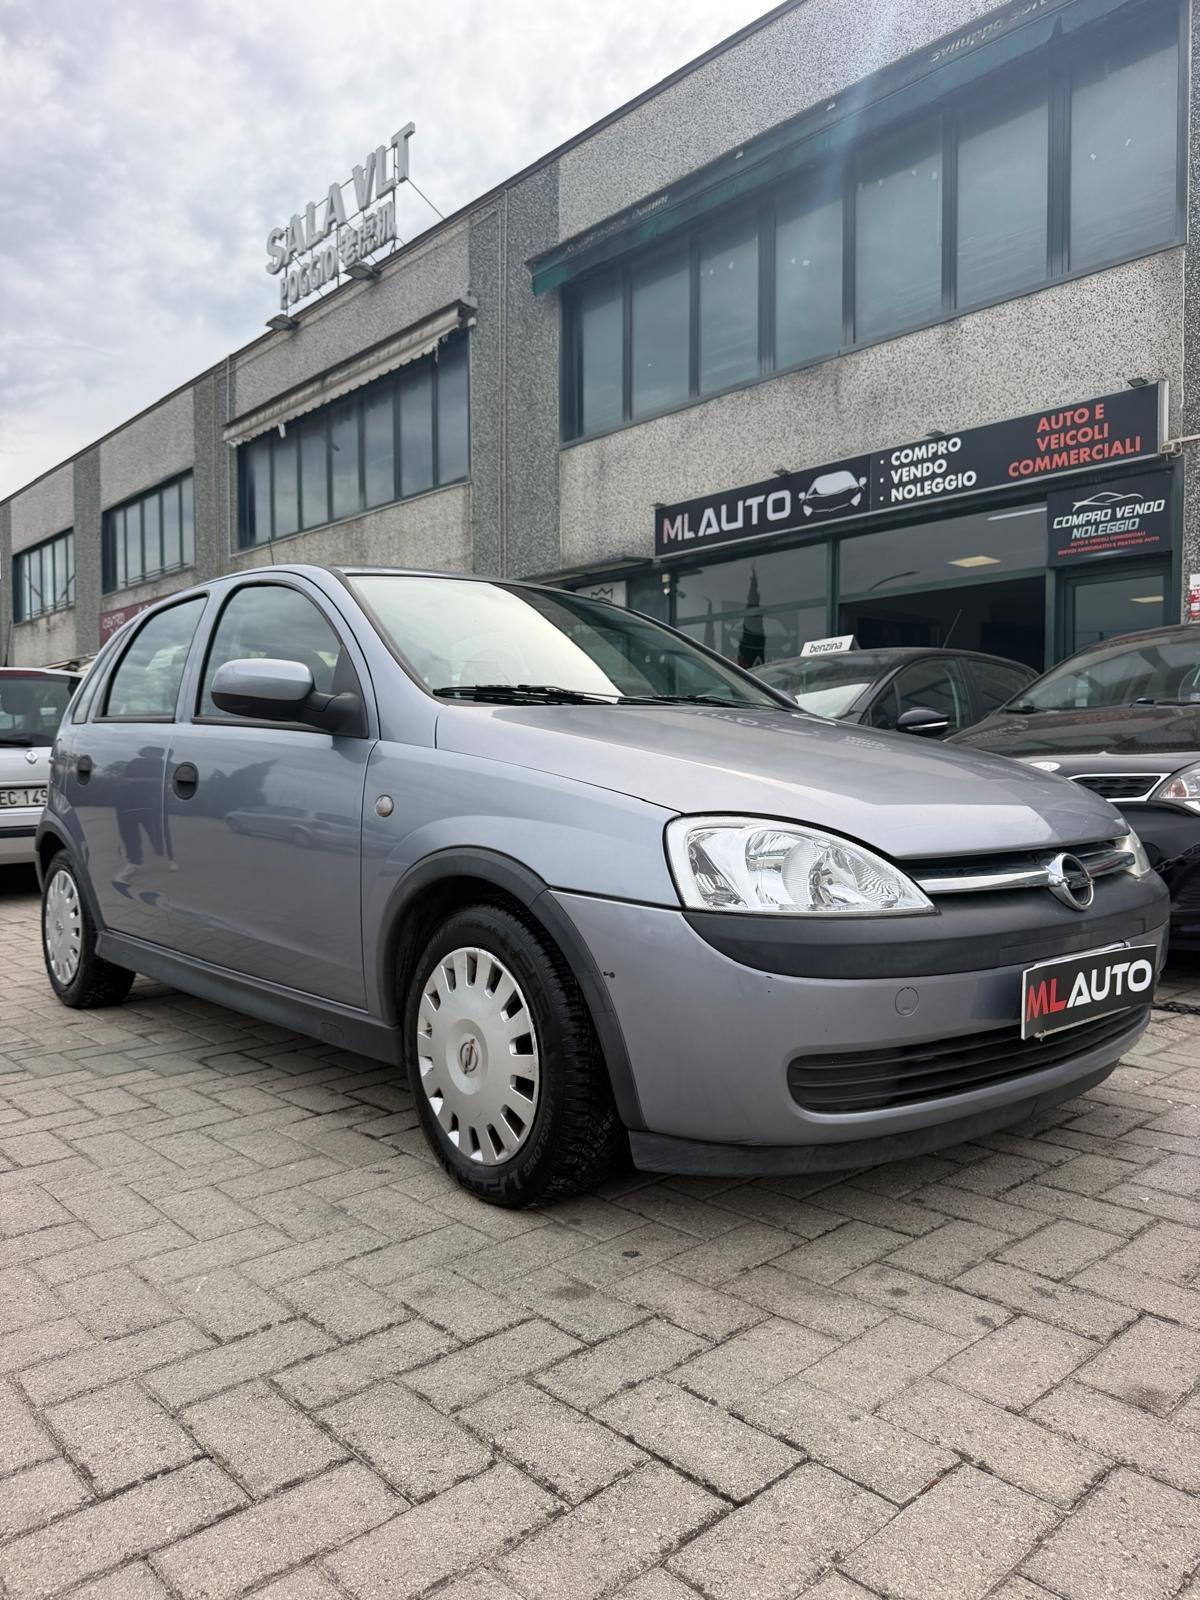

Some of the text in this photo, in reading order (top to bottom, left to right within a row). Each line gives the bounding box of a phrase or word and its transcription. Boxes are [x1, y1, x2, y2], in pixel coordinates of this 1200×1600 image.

[266, 121, 416, 275] SALA VLT
[280, 245, 338, 310] POGGIO
[1036, 403, 1105, 434] AUTO E
[890, 436, 962, 467] COMPRO
[1036, 422, 1109, 452] VEICOLI
[890, 458, 948, 484] VENDO
[1008, 435, 1141, 478] COMMERCIALI
[890, 470, 977, 502] NOLEGGIO
[1053, 499, 1166, 529] COMPRO VENDO
[1071, 517, 1140, 540] NOLEGGIO
[809, 641, 843, 653] benzina
[24, 789, 48, 805] 149
